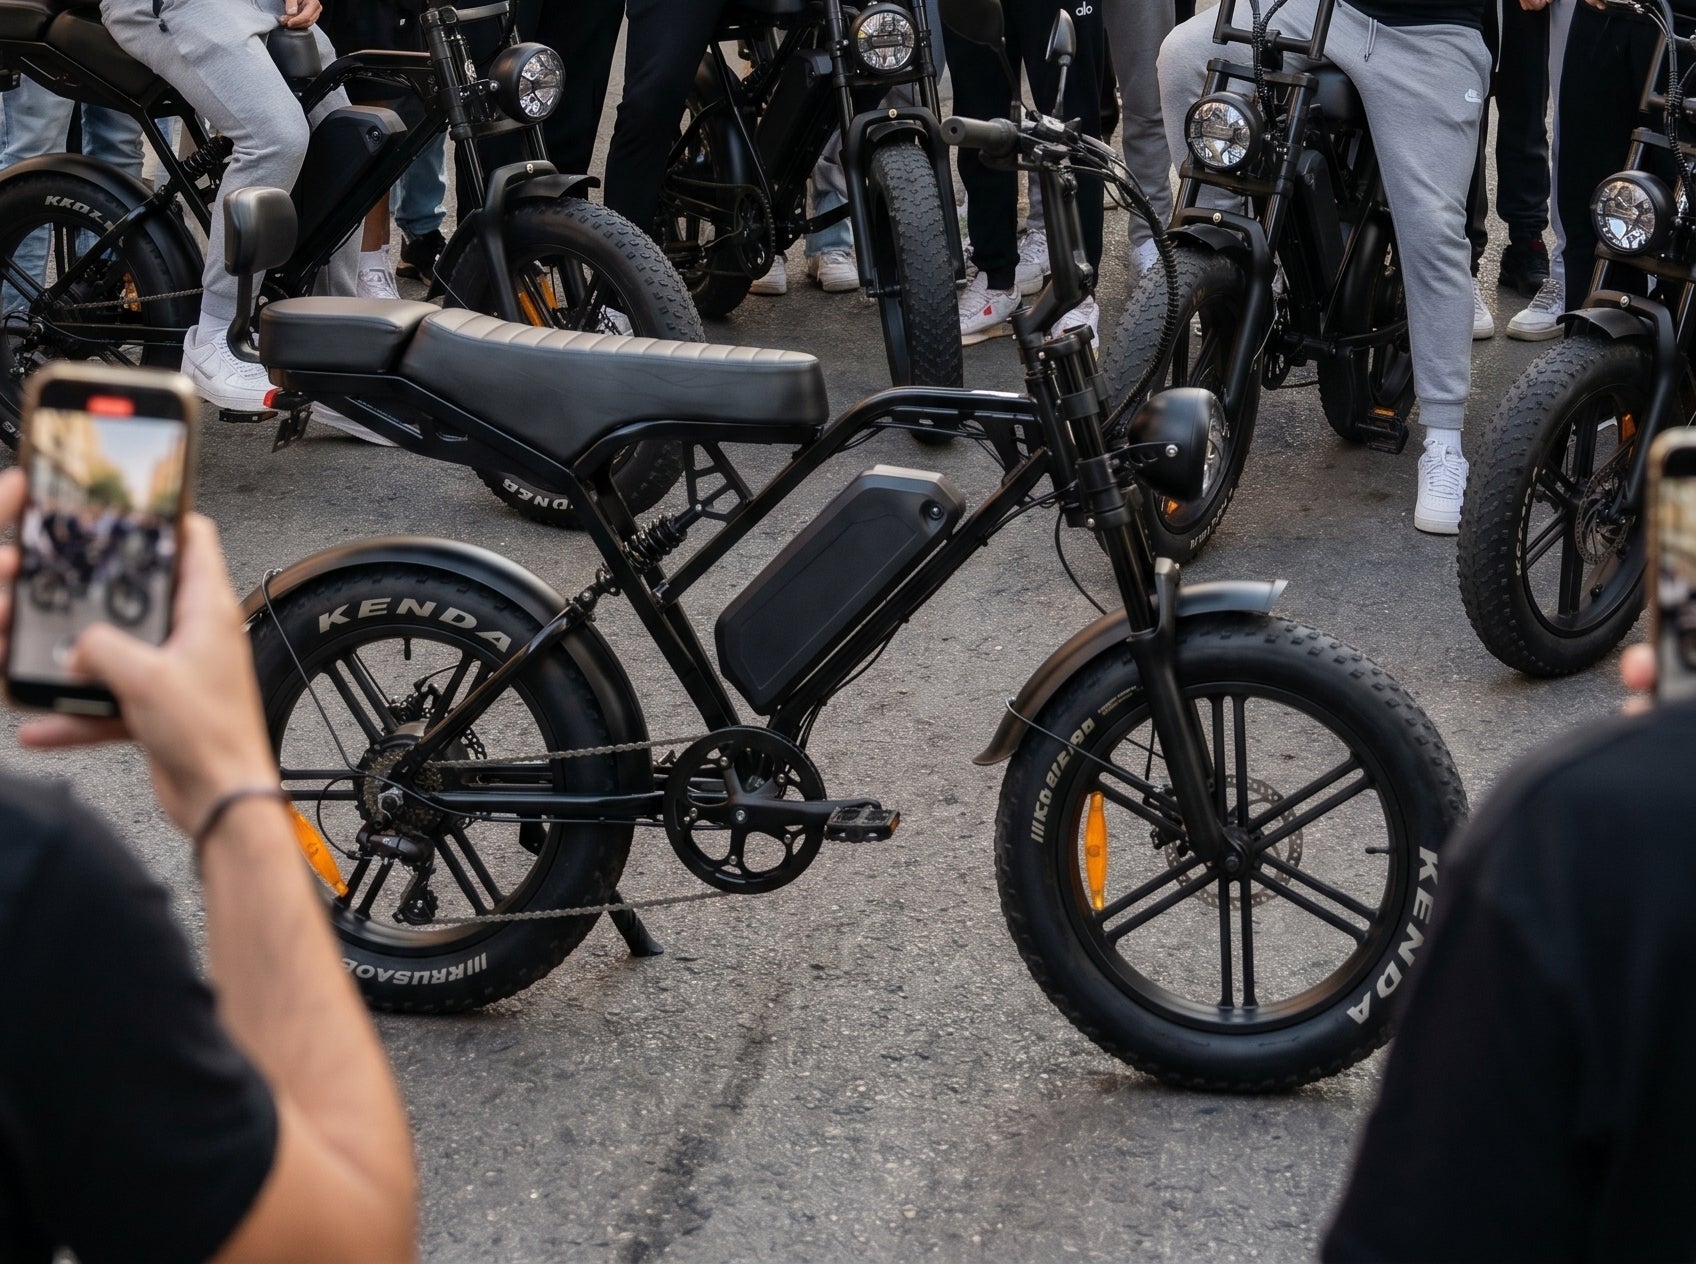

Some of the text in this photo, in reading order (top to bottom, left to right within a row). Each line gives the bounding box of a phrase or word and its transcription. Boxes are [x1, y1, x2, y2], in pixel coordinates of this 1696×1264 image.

[1075, 1, 1093, 16] alo
[318, 597, 512, 653] KENDA
[1346, 845, 1438, 1025] KENDA
